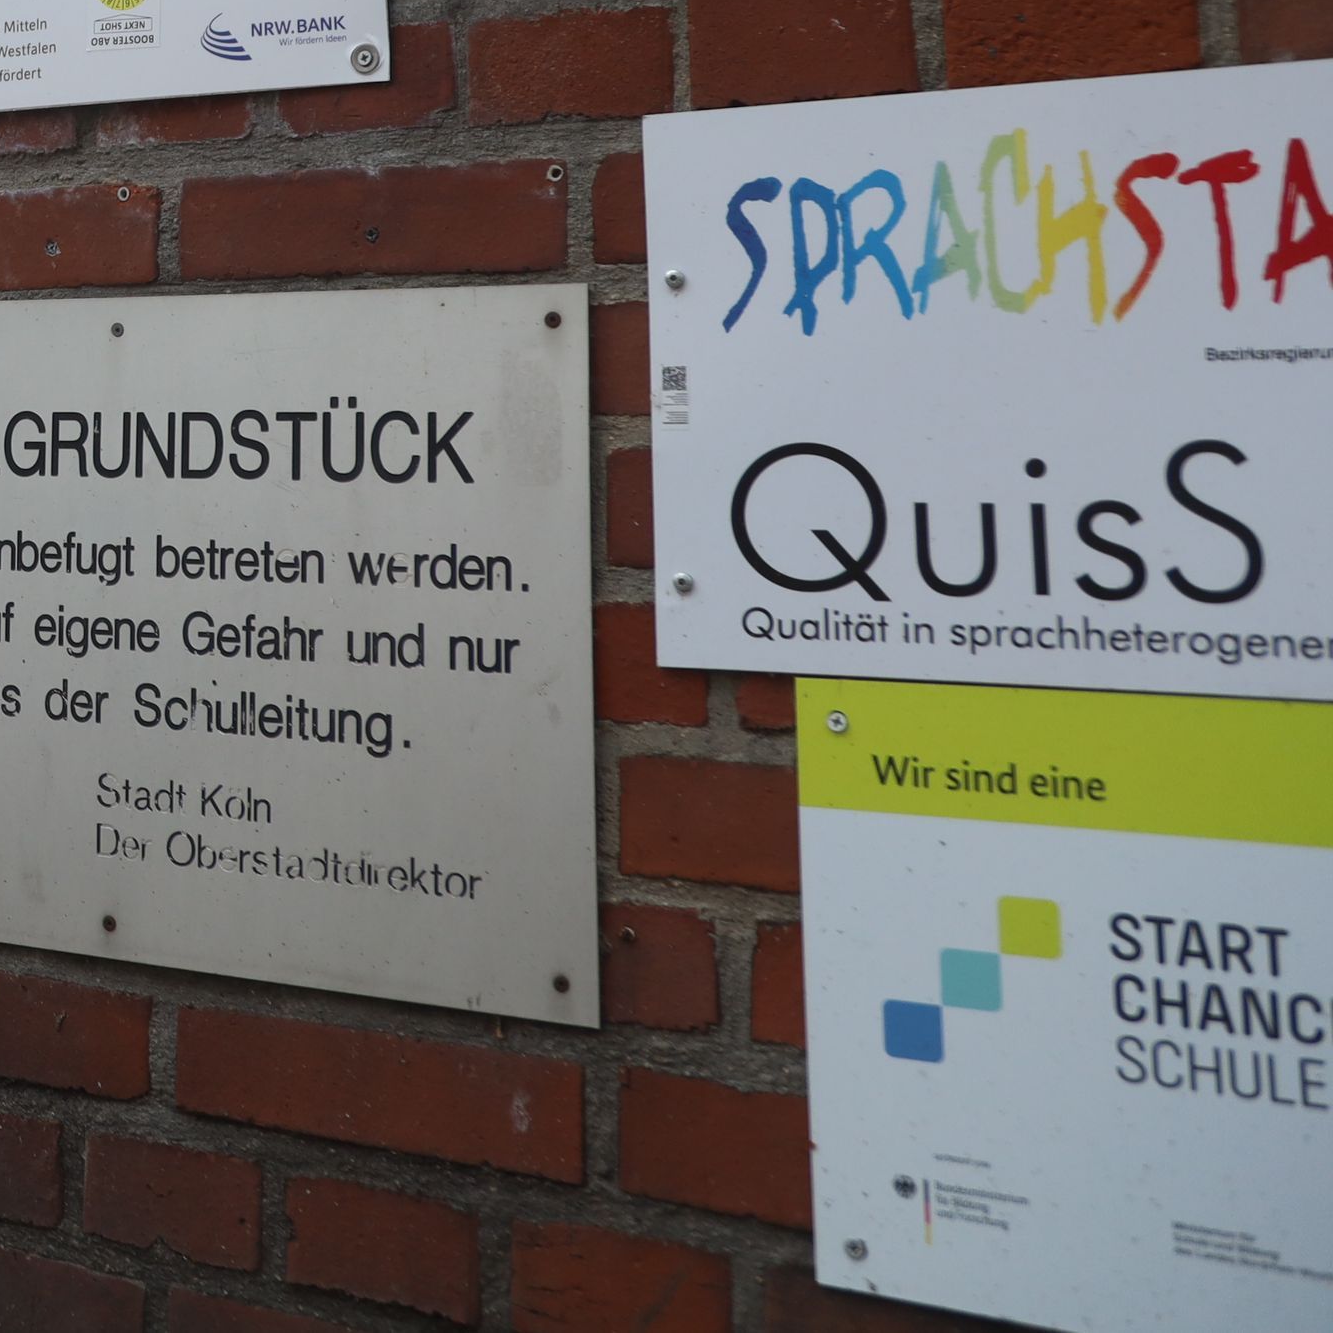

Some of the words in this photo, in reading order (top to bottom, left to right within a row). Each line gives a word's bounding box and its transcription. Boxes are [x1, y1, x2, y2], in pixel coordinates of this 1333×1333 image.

[3, 17, 48, 34] Mitteln
[113, 34, 155, 45] BOOSTER
[251, 15, 346, 37] NRW.BANK
[279, 37, 294, 47] Wir
[295, 35, 323, 46] fördern
[326, 33, 347, 43] Ideen
[722, 127, 1333, 336] SPRACHSTA
[730, 439, 1265, 605] QuisS
[155, 534, 325, 584] betreten
[347, 543, 530, 593] werden.
[34, 604, 161, 659] eigene
[182, 610, 324, 662] Gefahr
[346, 622, 425, 668] und
[448, 633, 521, 674] nur
[741, 606, 889, 644] Qualität
[902, 612, 935, 645] in
[949, 615, 1333, 666] sprachheterogene
[45, 678, 109, 724] der
[134, 682, 412, 759] Schulleitung.
[96, 772, 186, 815] Stadt
[200, 783, 272, 824] Köln
[871, 754, 935, 789] Wir
[944, 759, 1018, 796] sind
[1029, 765, 1107, 802] eine
[96, 822, 152, 862] Der
[165, 830, 483, 900] Oberstadtdirektor
[1109, 911, 1290, 978] START
[1113, 973, 1333, 1045] CHANC
[1116, 1034, 1330, 1112] SCHULE
